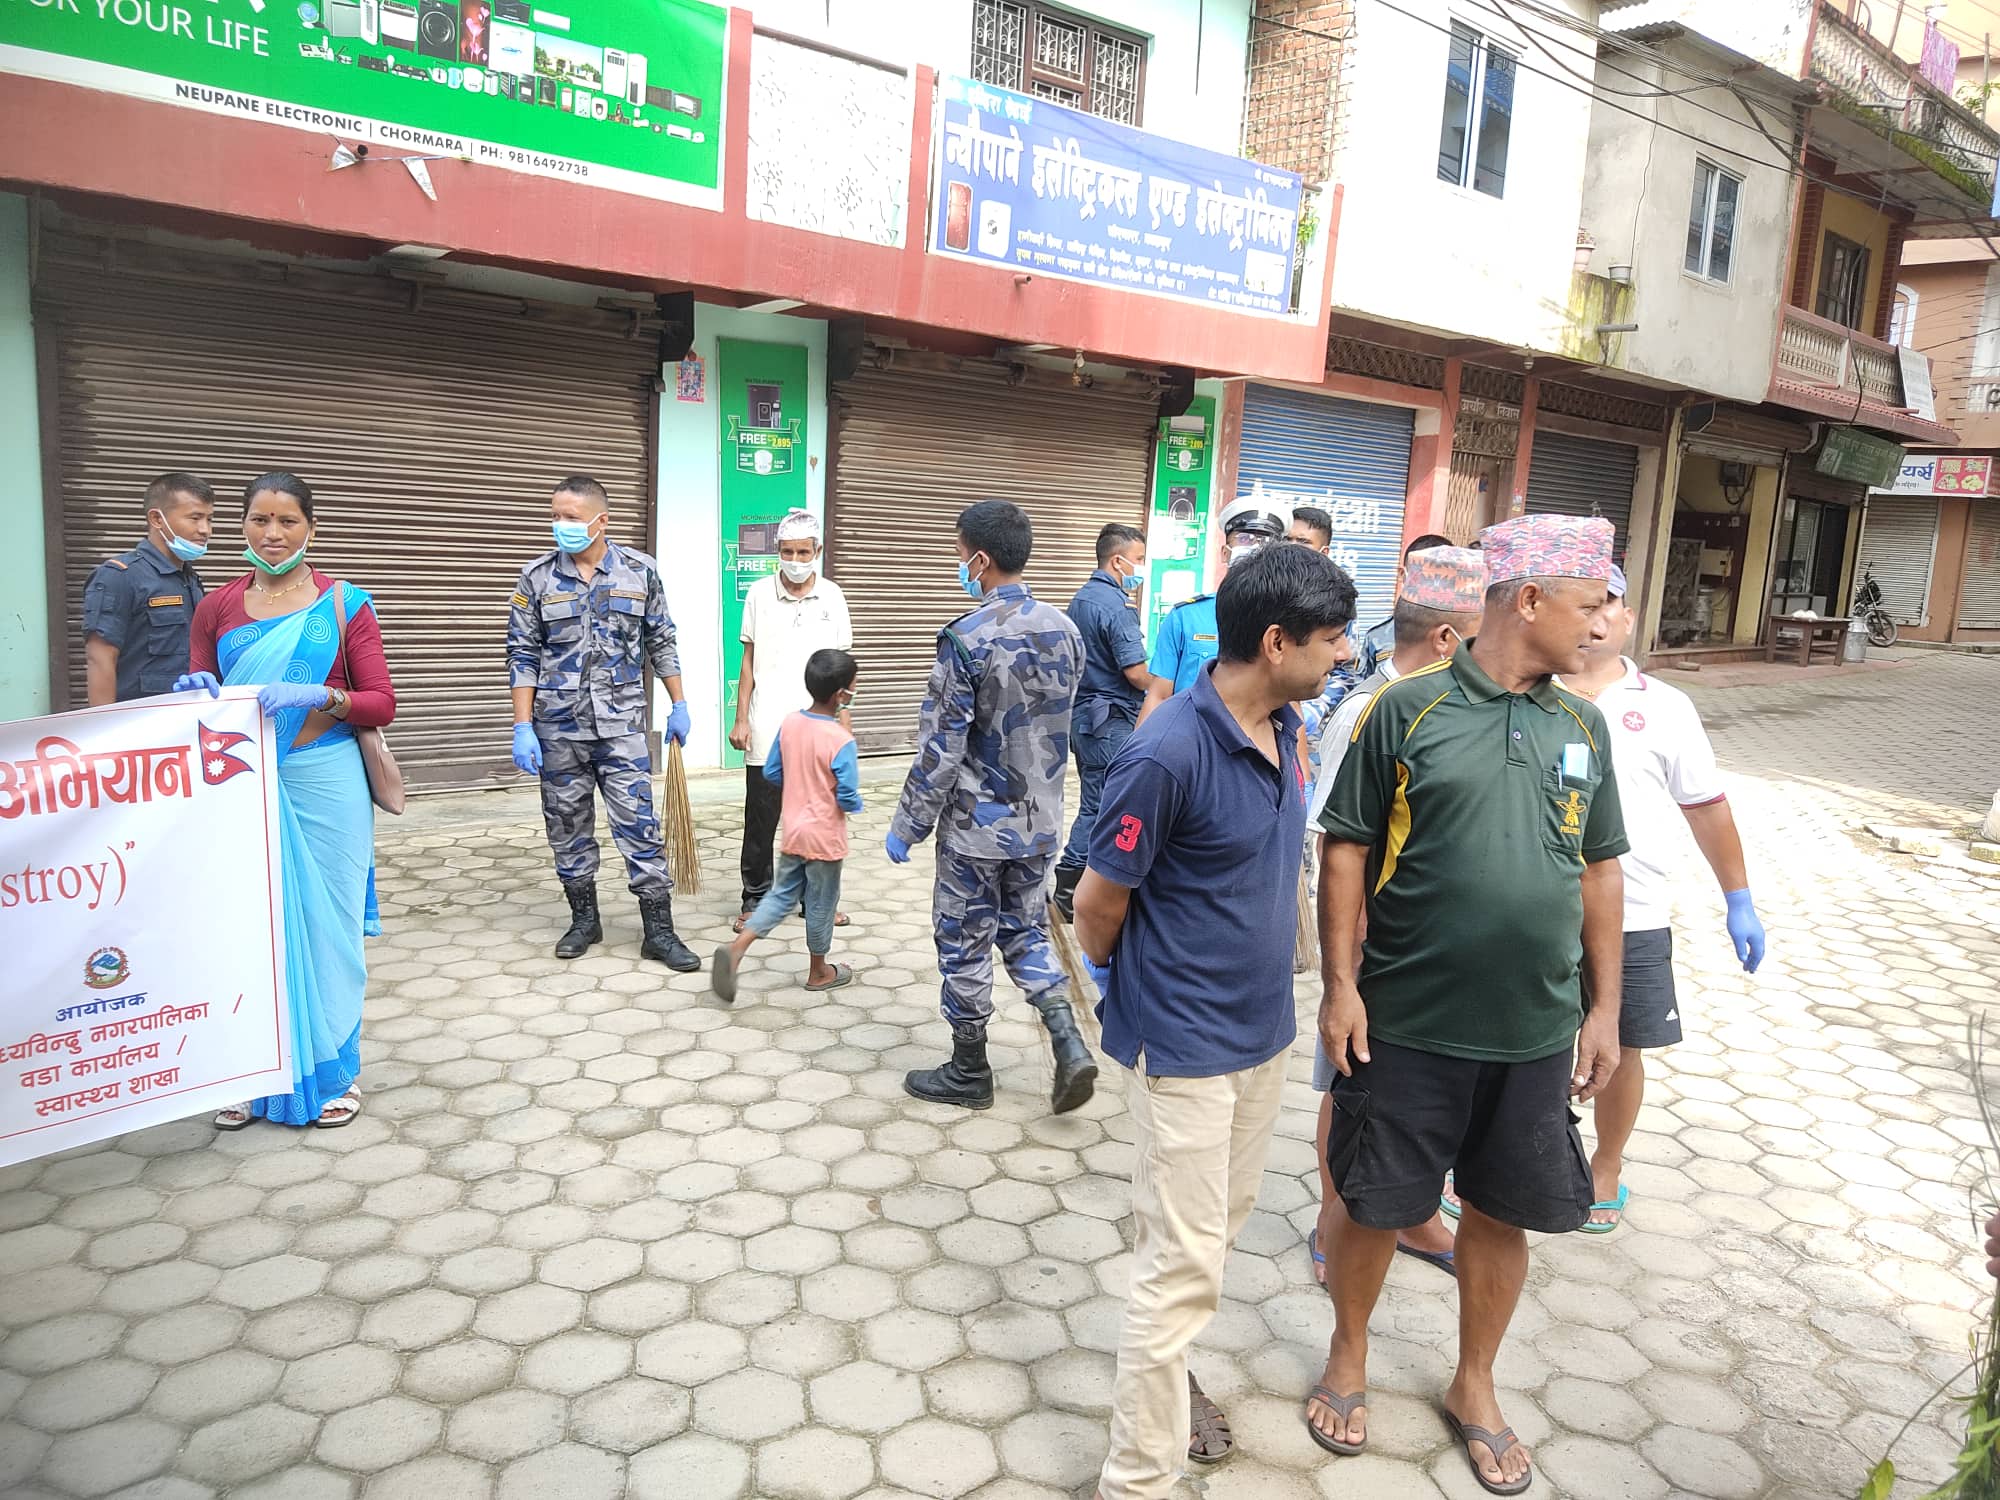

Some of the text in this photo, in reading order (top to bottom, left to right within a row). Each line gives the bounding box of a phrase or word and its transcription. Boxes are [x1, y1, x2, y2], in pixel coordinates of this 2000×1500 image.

[95, 0, 270, 57] YOUR LIFE
[175, 83, 260, 112] NEUPANE
[265, 102, 363, 133] ELECTRONIC
[380, 125, 464, 152] CHORMARA
[480, 145, 504, 160] PH:
[508, 150, 589, 177] 9816492738
[1148, 175, 1192, 231] एण्ड
[740, 432, 767, 445] FREE
[1169, 435, 1188, 446] FREE
[737, 560, 767, 572] FREE
[0, 736, 192, 819] अभियान
[1115, 814, 1143, 852] 3
[55, 991, 148, 1022] आयोजक
[89, 1001, 209, 1044] नगरपालिका
[20, 1064, 62, 1089] वडा
[70, 1042, 161, 1077] कार्यालय
[34, 1066, 181, 1118] स्वास्थ्य शाखा
